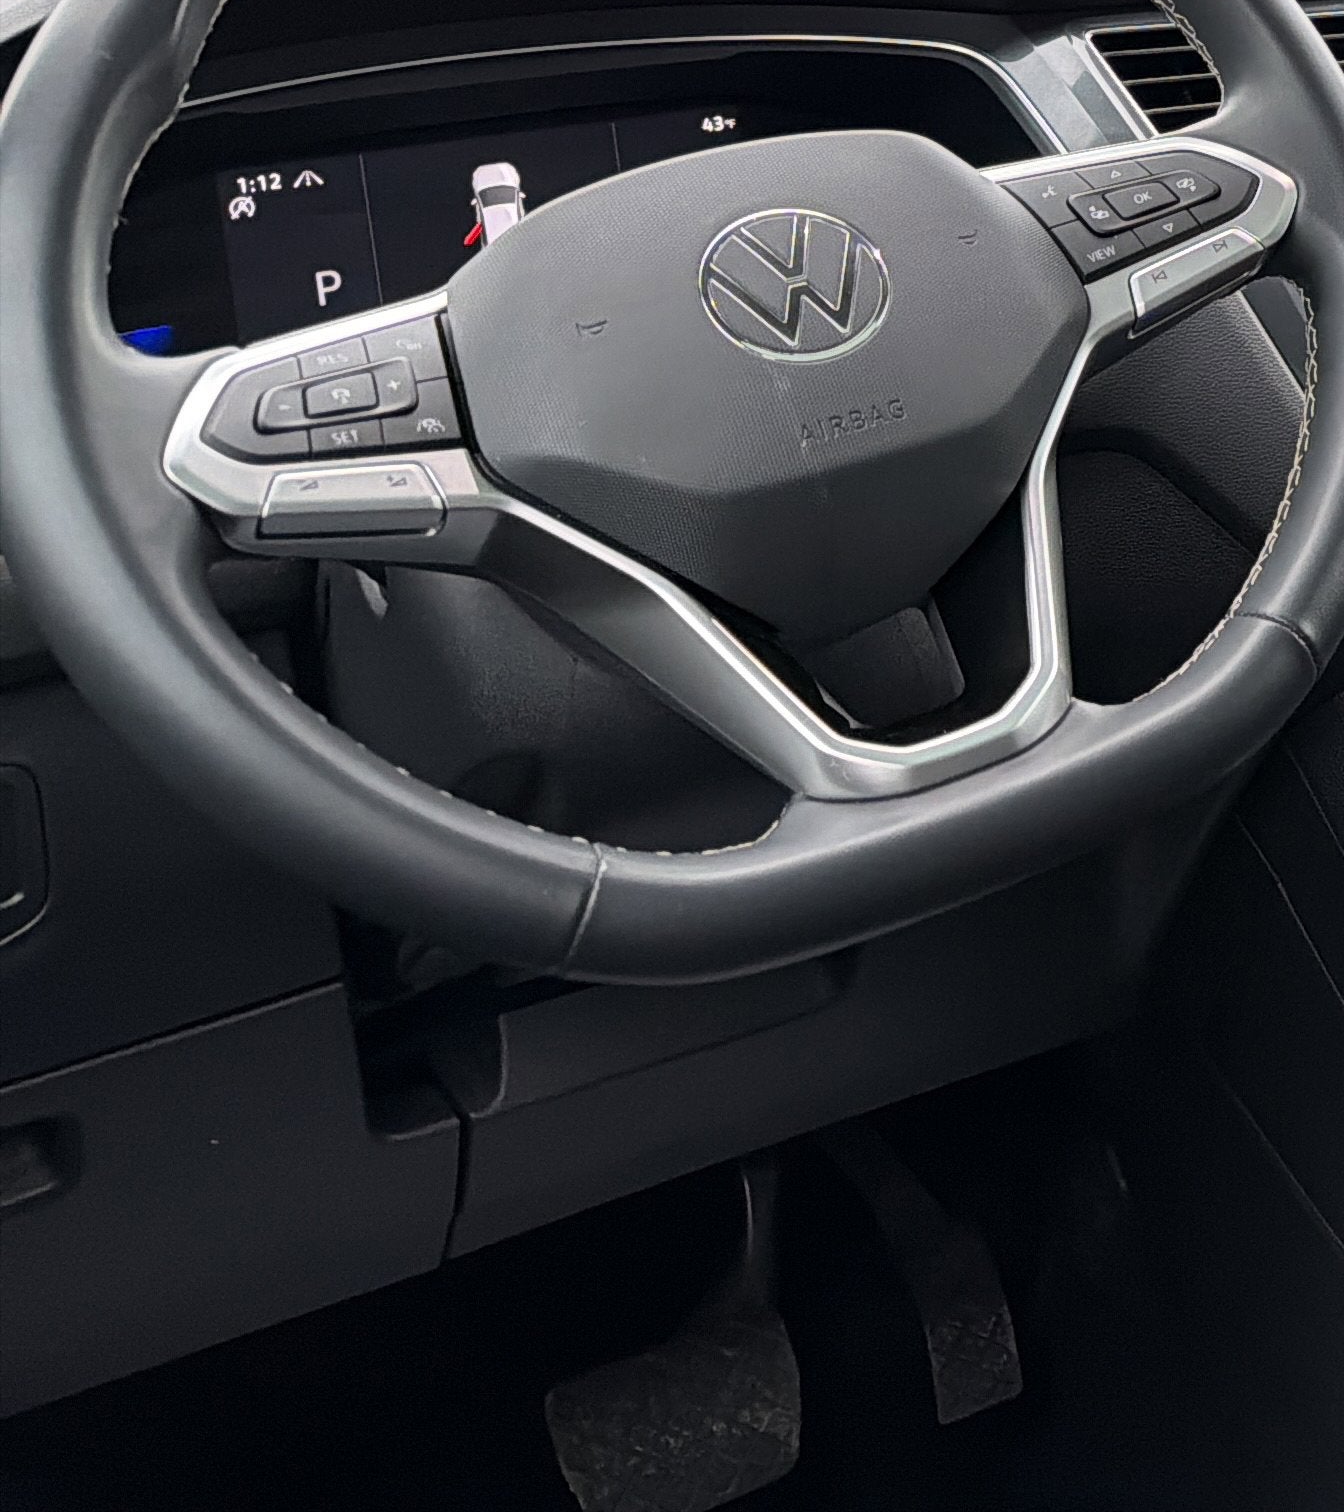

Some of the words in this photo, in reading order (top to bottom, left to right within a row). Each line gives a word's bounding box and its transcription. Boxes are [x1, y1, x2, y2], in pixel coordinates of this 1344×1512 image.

[236, 172, 283, 194] 1:12
[1133, 190, 1153, 205] OK
[1086, 244, 1117, 263] VIEW
[315, 269, 342, 307] P
[316, 353, 349, 367] RES
[801, 398, 906, 447] AIRBAG
[331, 429, 360, 445] SET
